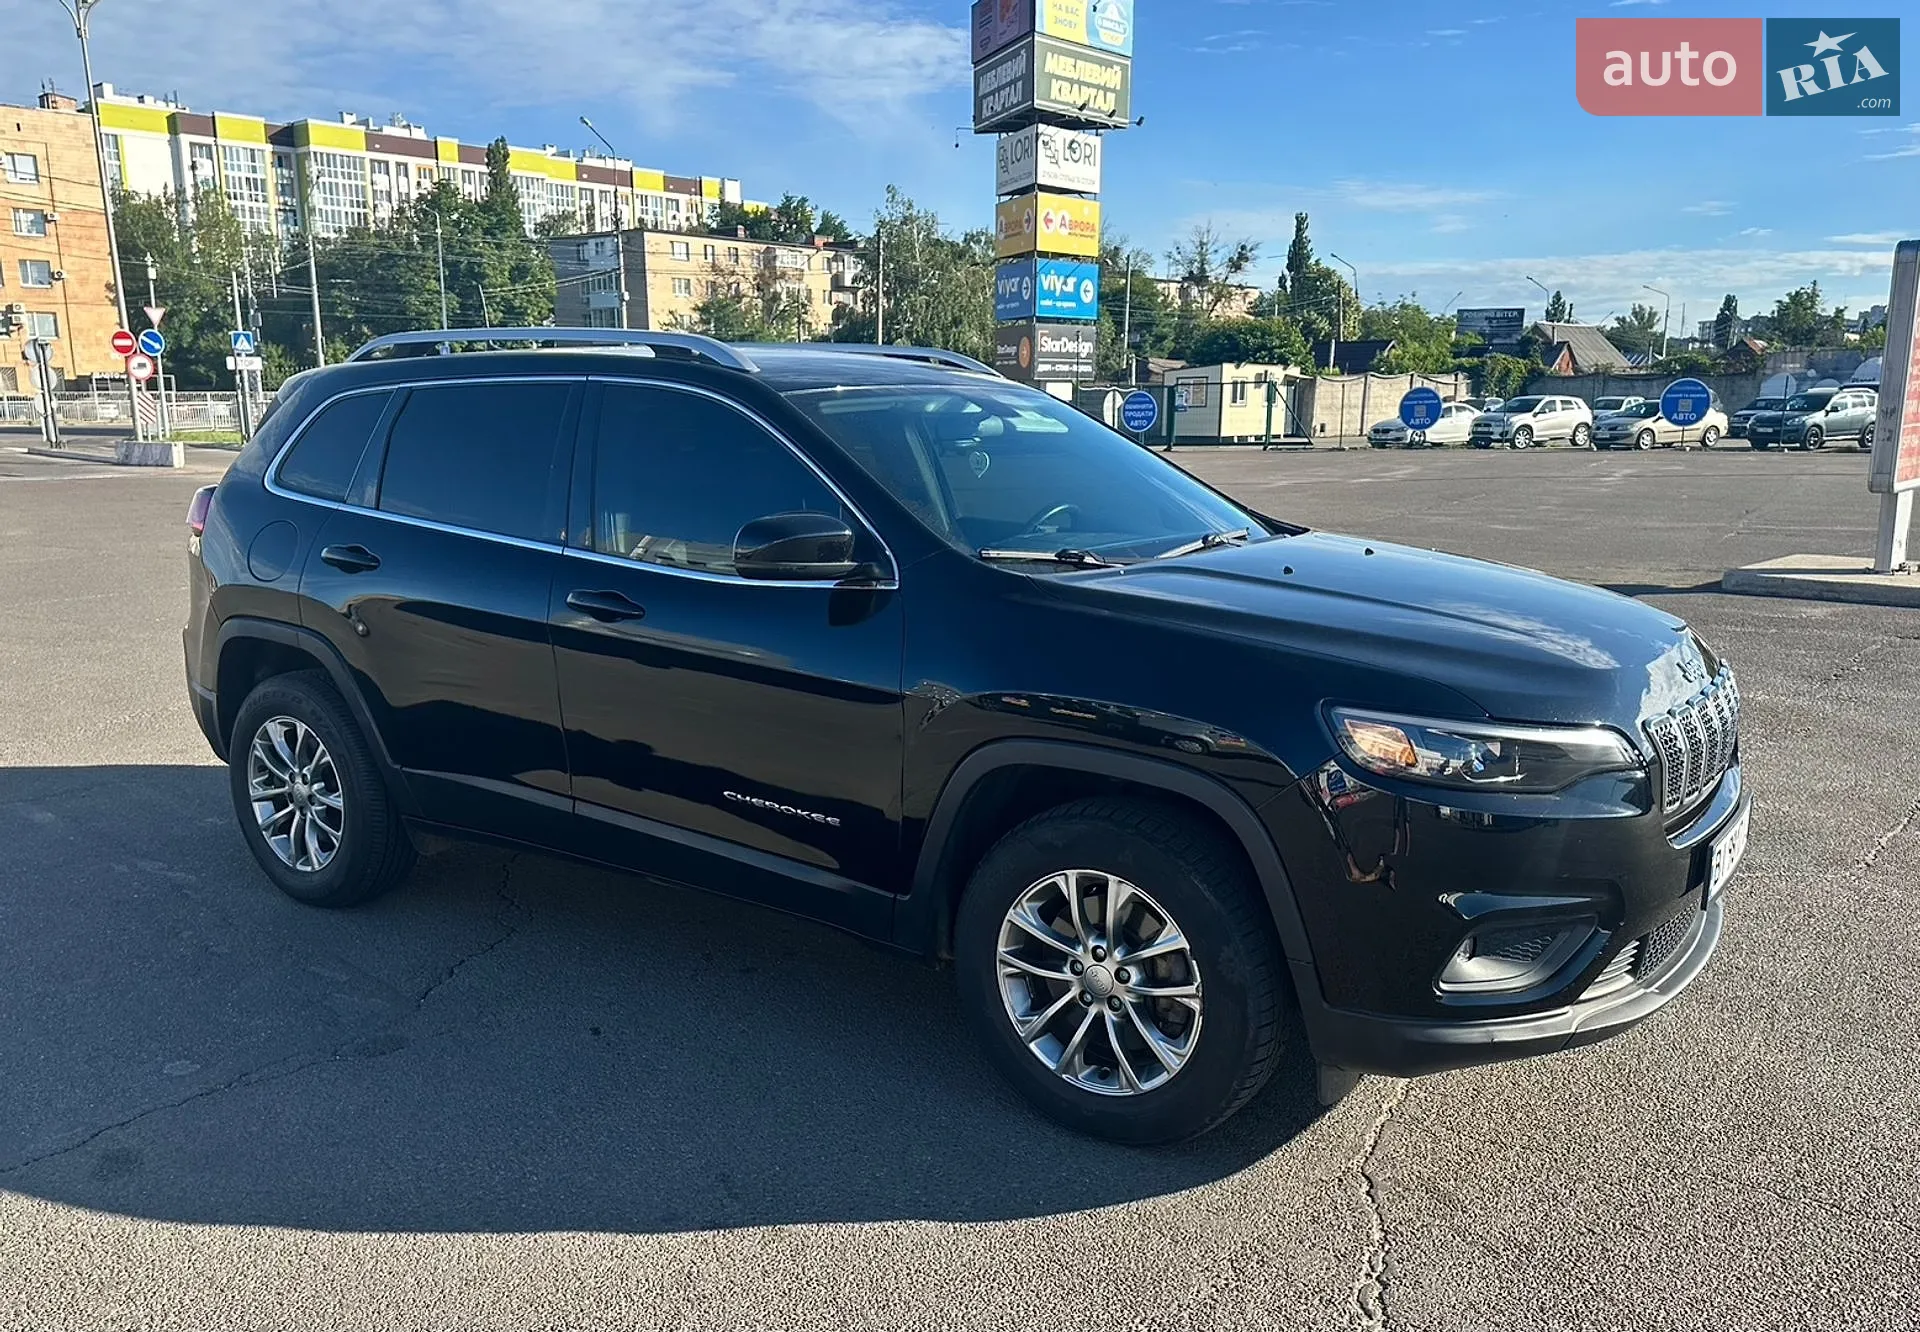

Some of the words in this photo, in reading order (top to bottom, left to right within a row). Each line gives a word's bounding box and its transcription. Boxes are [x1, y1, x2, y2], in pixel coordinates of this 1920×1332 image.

[979, 49, 1027, 97] МЕБЛЕВИЙ
[1044, 51, 1122, 91] МЕБЛЕВИЙ
[981, 80, 1023, 119] КВАРТАЛ
[1050, 78, 1117, 112] КВАРТАЛ
[1010, 133, 1033, 166] LORI
[1063, 137, 1097, 167] LORI
[1129, 419, 1148, 427] АВТО
[1410, 417, 1431, 426] АВТО
[1671, 412, 1697, 421] АВТО
[722, 790, 841, 827] CHEROKEE
